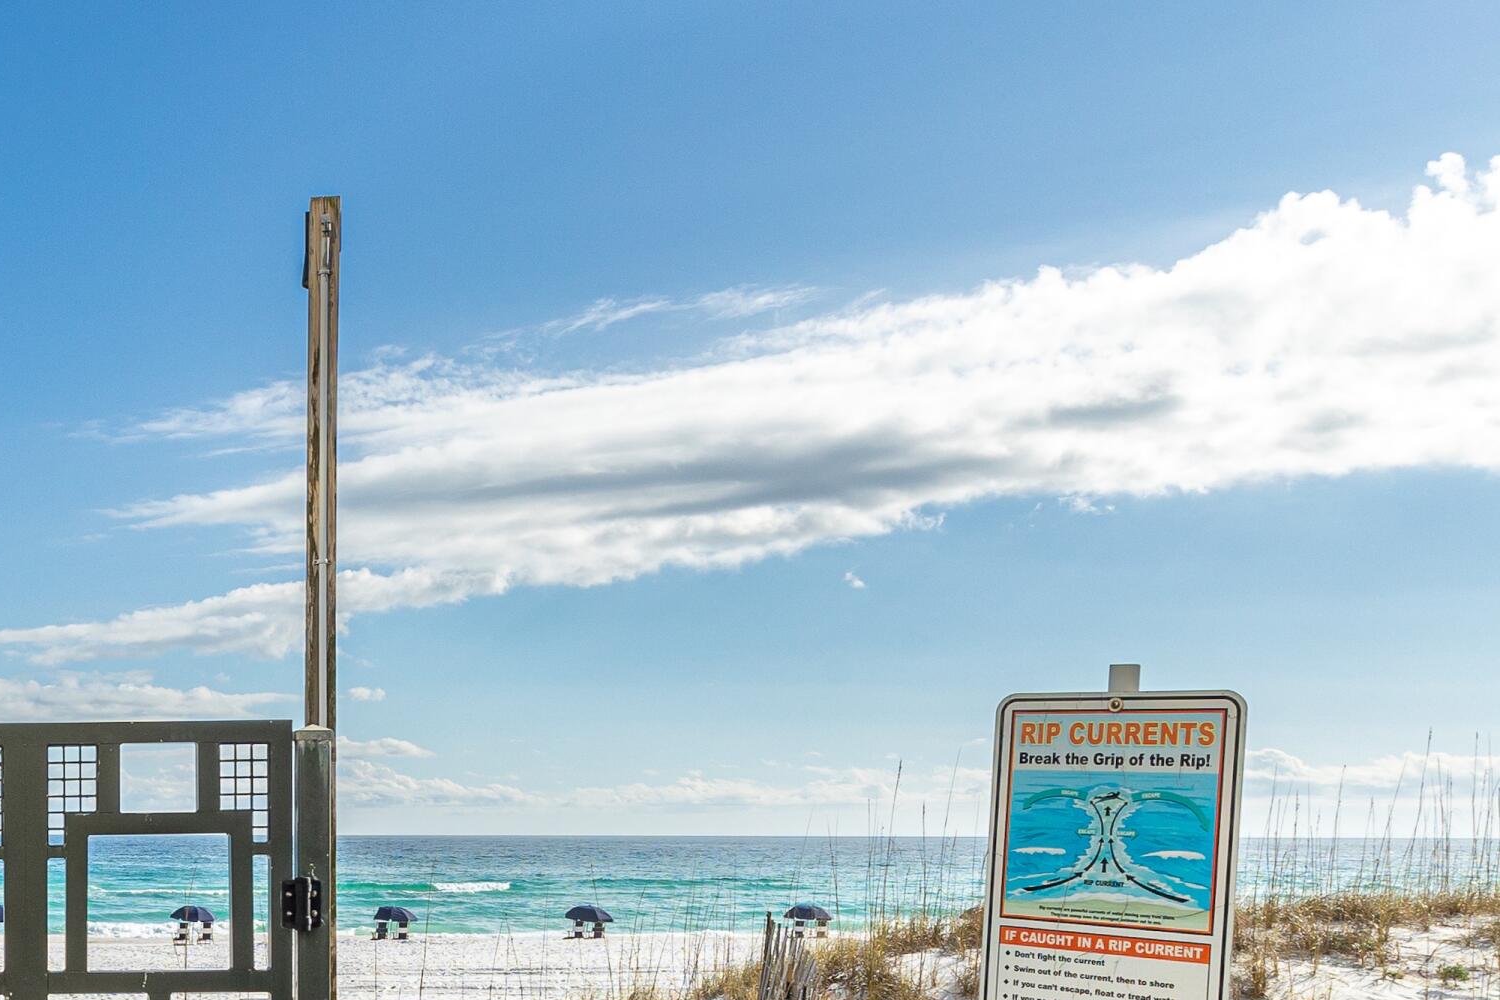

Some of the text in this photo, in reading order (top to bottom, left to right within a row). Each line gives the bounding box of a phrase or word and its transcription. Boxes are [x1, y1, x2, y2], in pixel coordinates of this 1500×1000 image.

[1021, 722, 1215, 746] RIP CURRENTS
[1019, 752, 1210, 770] Break the Grip of the Rip!
[1005, 930, 1203, 959] IF CAUGHT IN A RIP CURRENT
[1014, 950, 1105, 966] Don't fight the current
[1014, 965, 1036, 974] Swim
[1079, 974, 1113, 983] current,
[1116, 976, 1135, 984] then
[1149, 980, 1175, 989] shore
[1060, 986, 1092, 996] escape,
[1095, 989, 1114, 997] float
